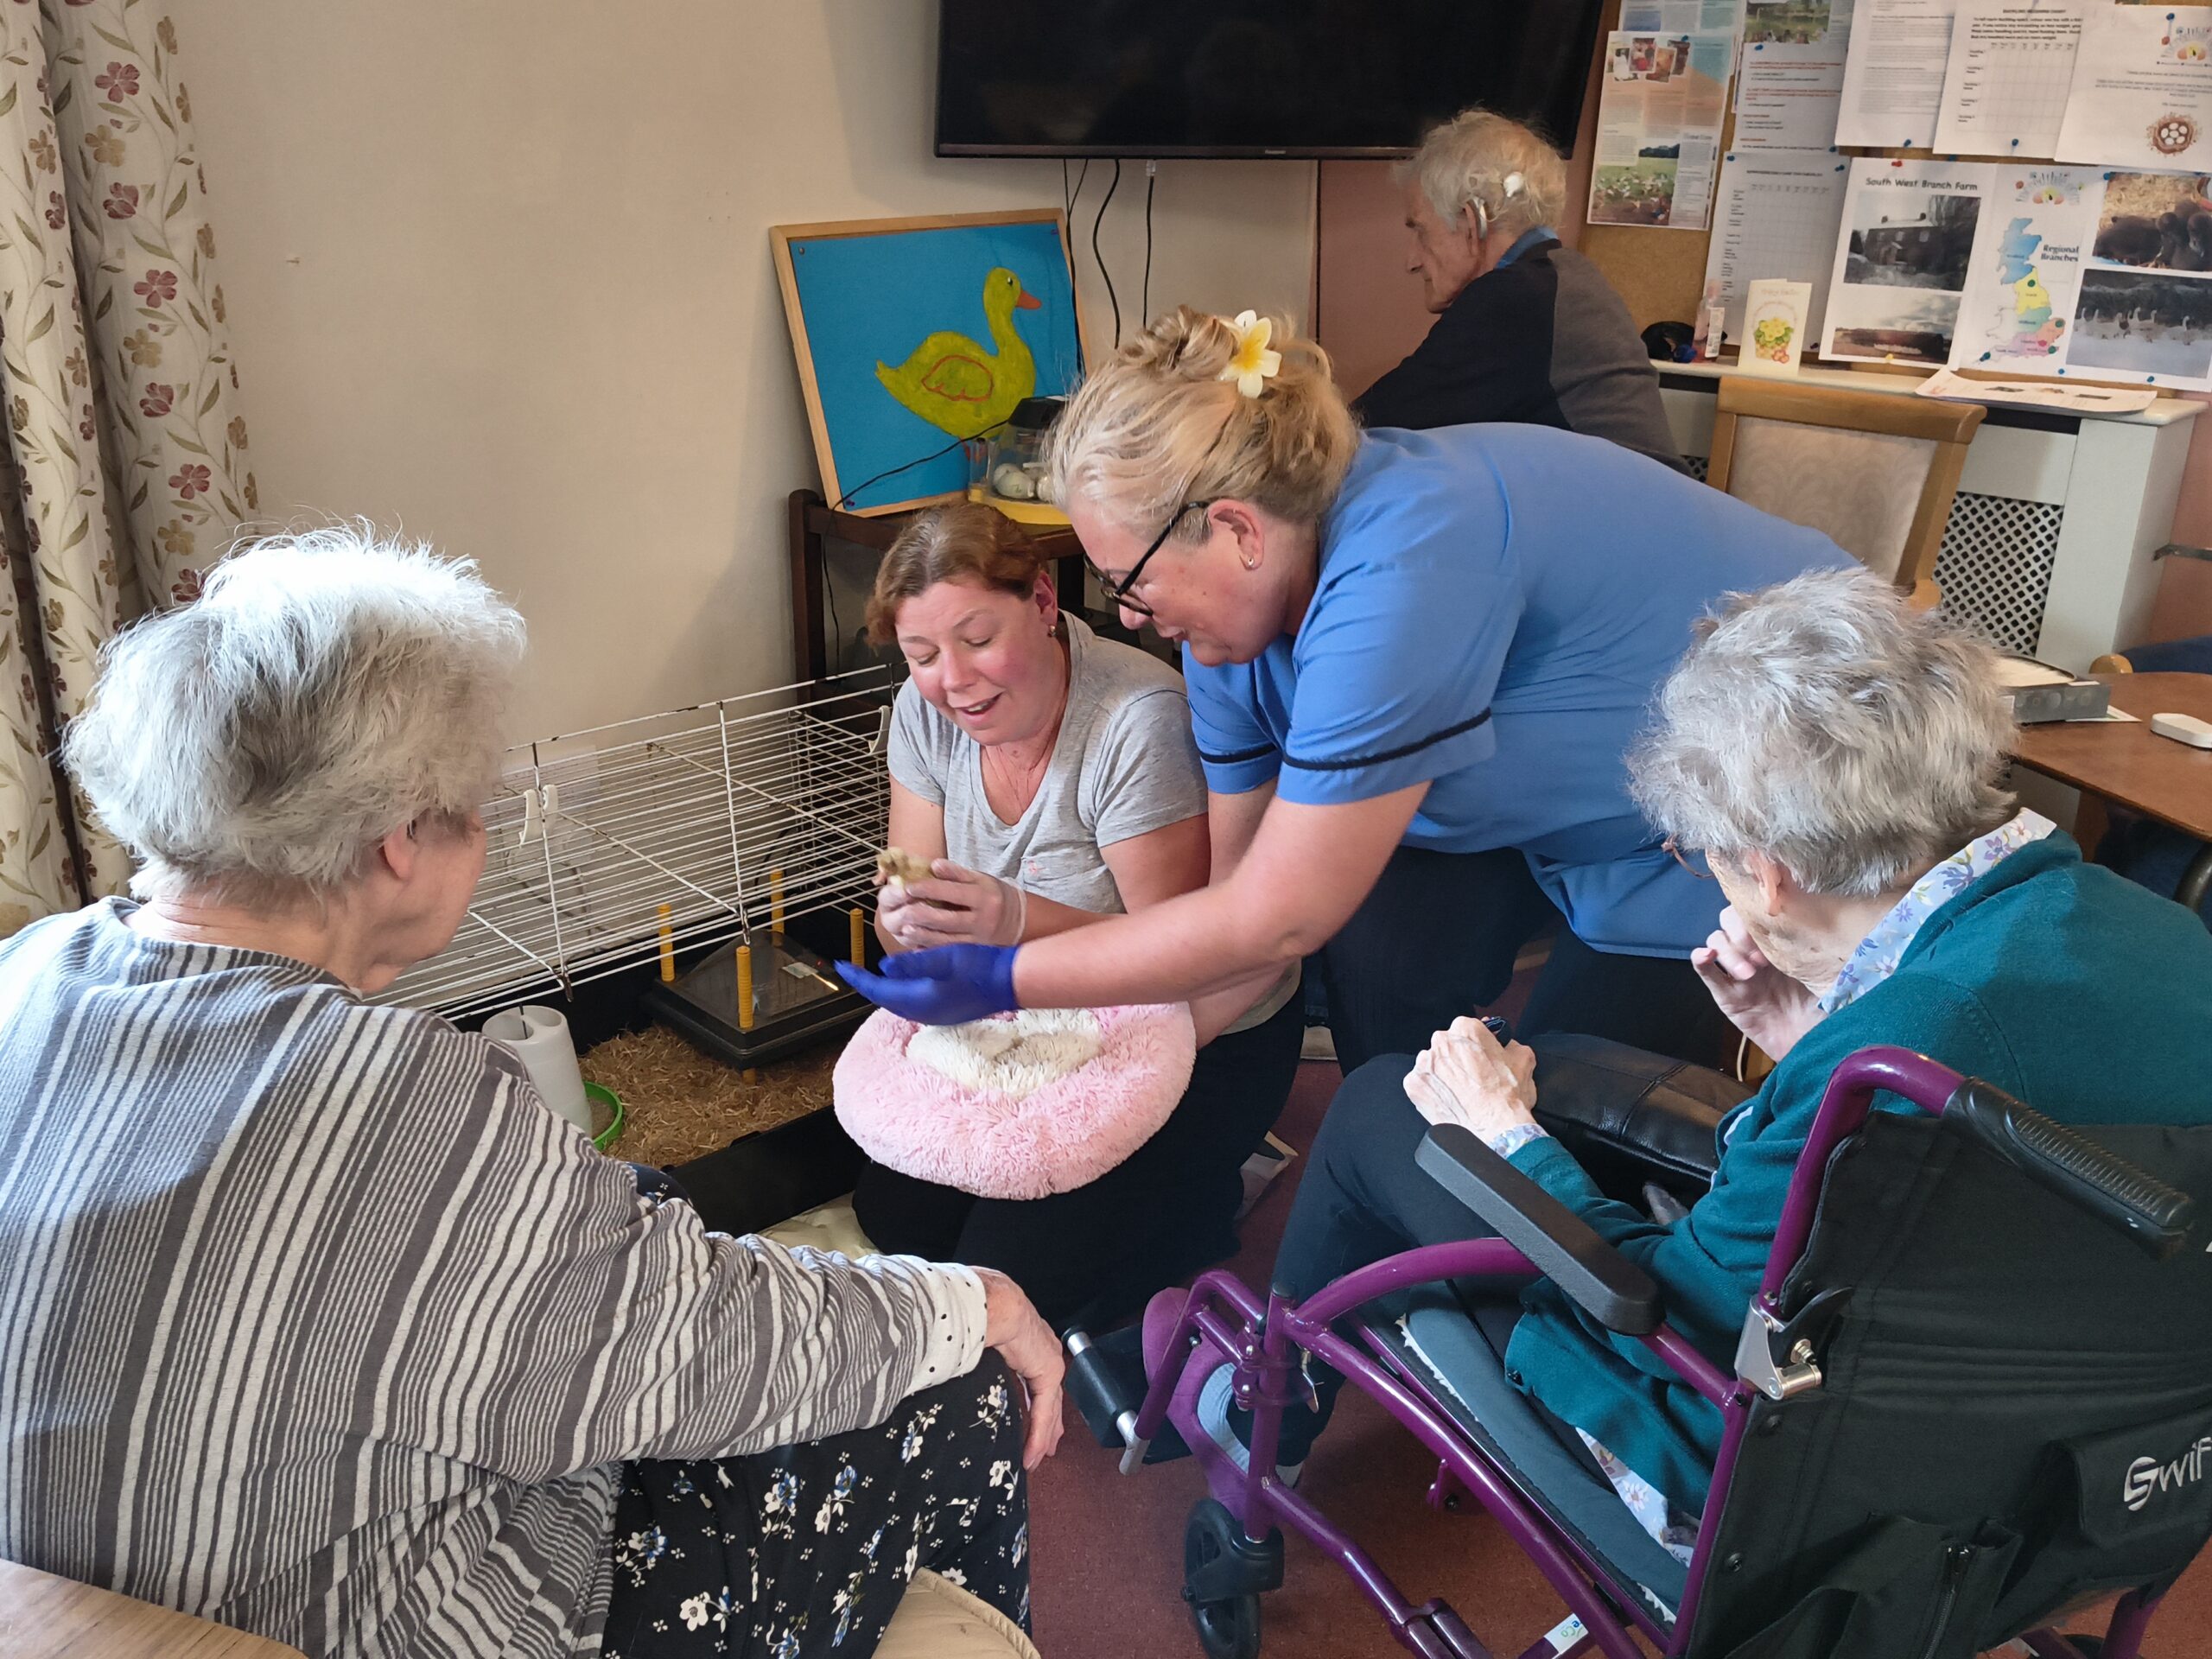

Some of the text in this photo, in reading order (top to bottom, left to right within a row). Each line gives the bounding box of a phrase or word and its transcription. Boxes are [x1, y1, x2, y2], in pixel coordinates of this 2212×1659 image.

[1866, 177, 1978, 191] South West Branch Farm
[2043, 245, 2079, 255] Regional
[2040, 253, 2078, 262] Branches
[2124, 1437, 2212, 1511] Swif
